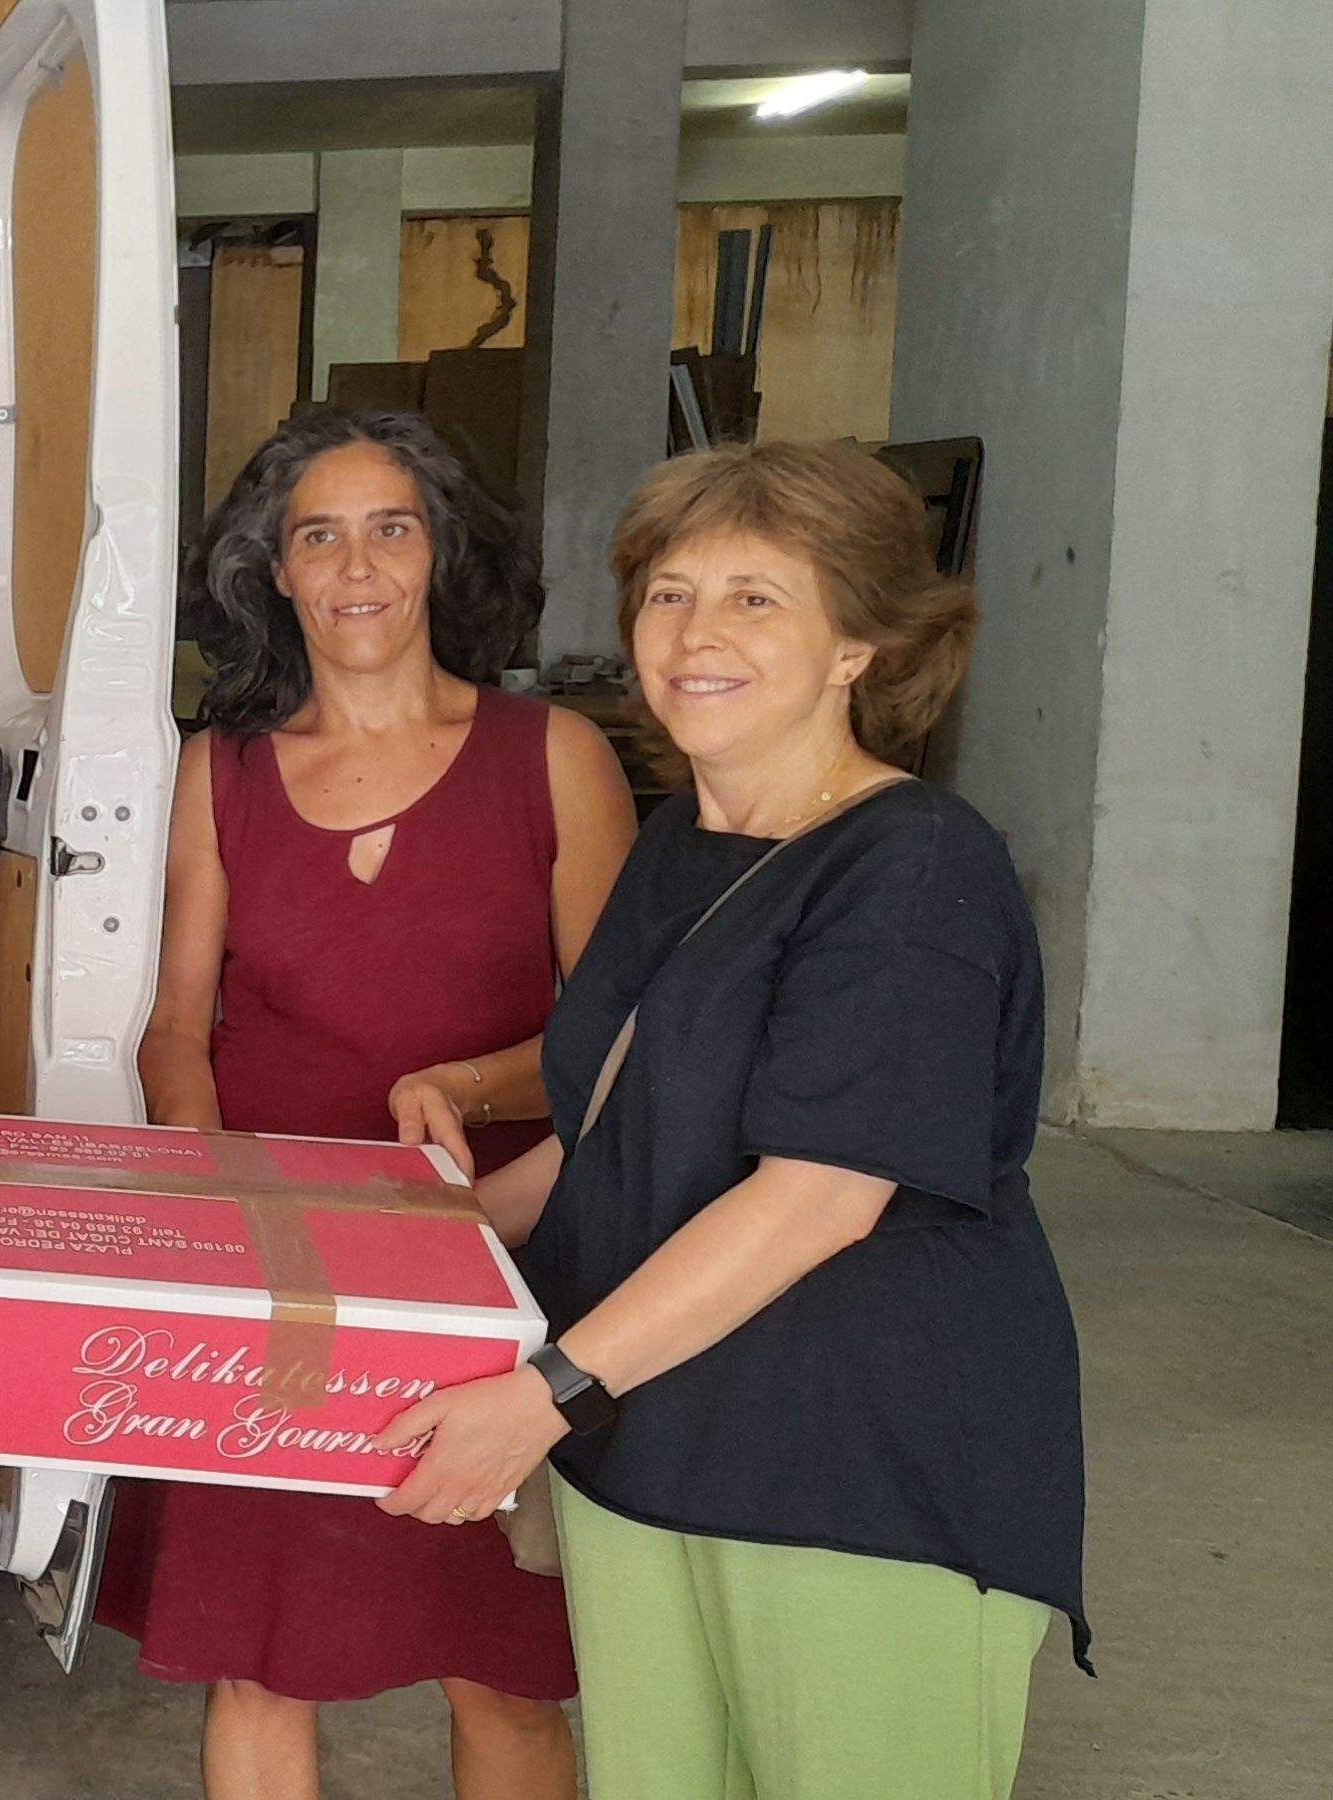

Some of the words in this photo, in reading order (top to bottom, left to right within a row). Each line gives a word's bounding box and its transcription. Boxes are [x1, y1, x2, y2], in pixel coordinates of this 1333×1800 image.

[22, 1227, 62, 1240] DEL
[61, 1222, 82, 1232] 04
[67, 1229, 132, 1245] CUGAT
[136, 1237, 188, 1249] SANT
[70, 1241, 134, 1256] PLAZA
[62, 1379, 209, 1446] Gran
